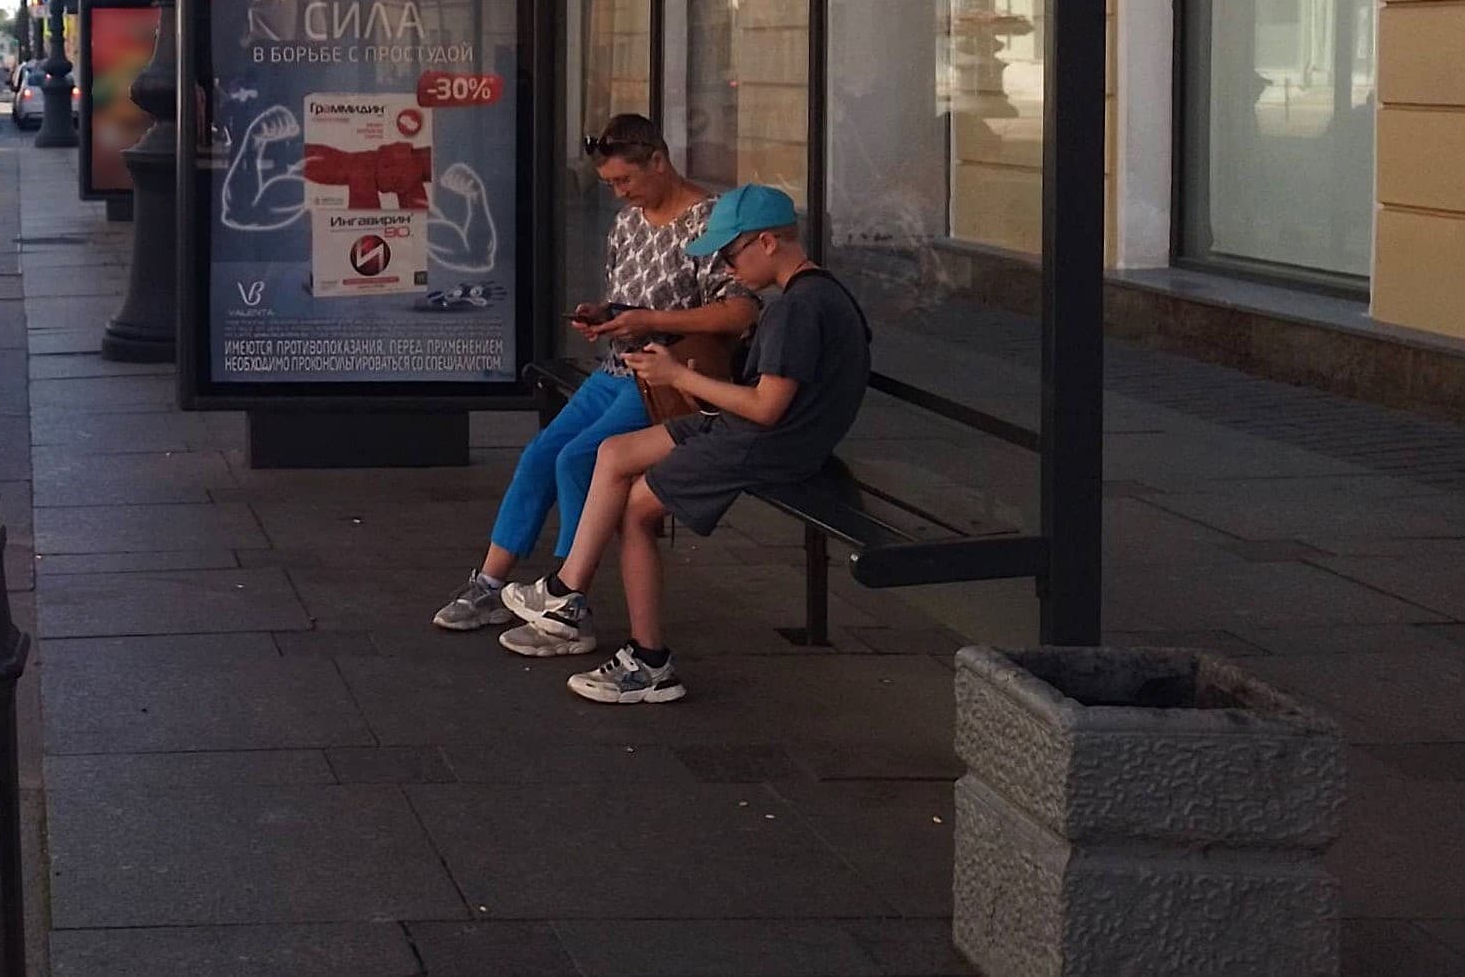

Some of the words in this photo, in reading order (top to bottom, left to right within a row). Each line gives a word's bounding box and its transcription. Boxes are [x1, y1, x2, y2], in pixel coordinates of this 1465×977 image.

[304, 2, 425, 41] СИЛА
[253, 46, 265, 63] В
[271, 46, 342, 63] БОРЬБЕ
[348, 46, 358, 63] С
[365, 41, 474, 64] ПРОСТУДОЙ
[330, 215, 411, 228] Ингавирин
[224, 340, 272, 355] ИМЕЮТСЯ
[390, 339, 423, 355] ПЕРЕД
[427, 339, 503, 355] ПРИМЕНЕНИЕМ
[224, 356, 290, 372] НЕОБХОДИМО
[291, 355, 410, 372] ПРОКОНСУЛЬТИРОВАТЬСЯ
[411, 355, 424, 371] СО
[426, 355, 502, 371] СПЕЦИАЛИСТОМ
